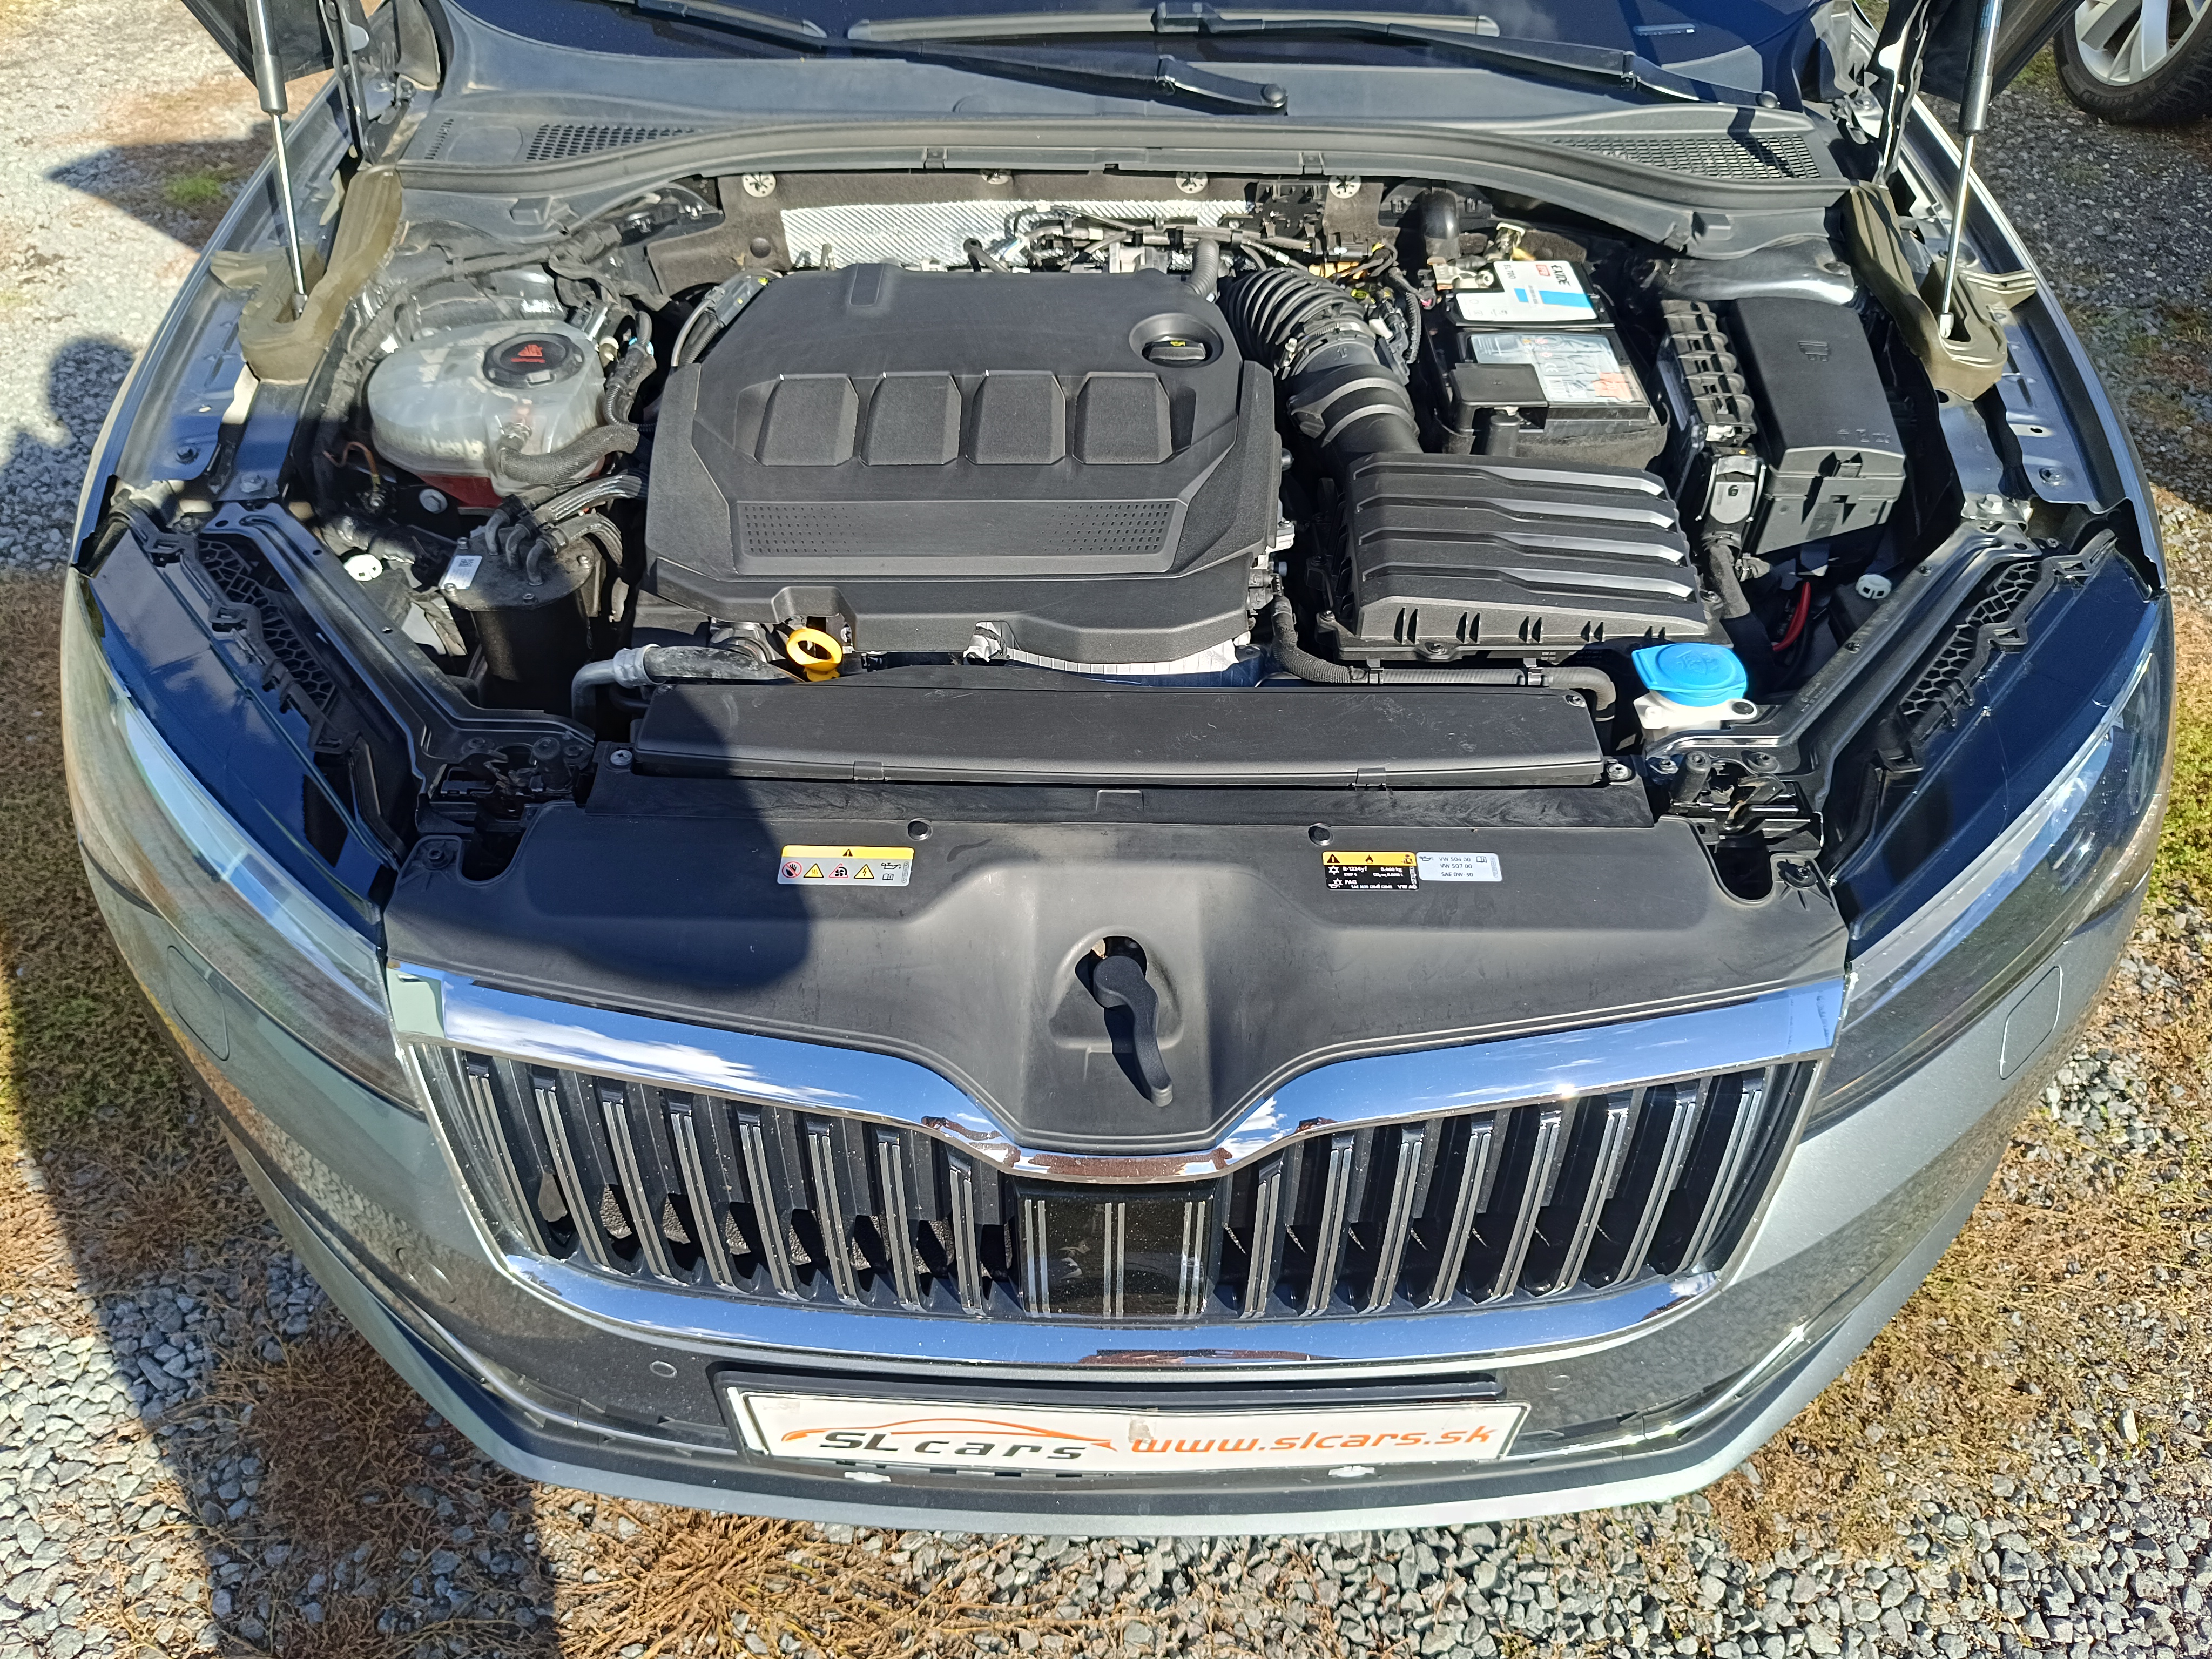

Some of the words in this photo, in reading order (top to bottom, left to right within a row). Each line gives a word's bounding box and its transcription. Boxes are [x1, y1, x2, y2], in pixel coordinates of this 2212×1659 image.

[1551, 265, 1571, 287] EXIDE
[819, 1432, 899, 1452] SL
[914, 1440, 1087, 1459] cars
[1131, 1425, 1498, 1453] www.slcars.sk
